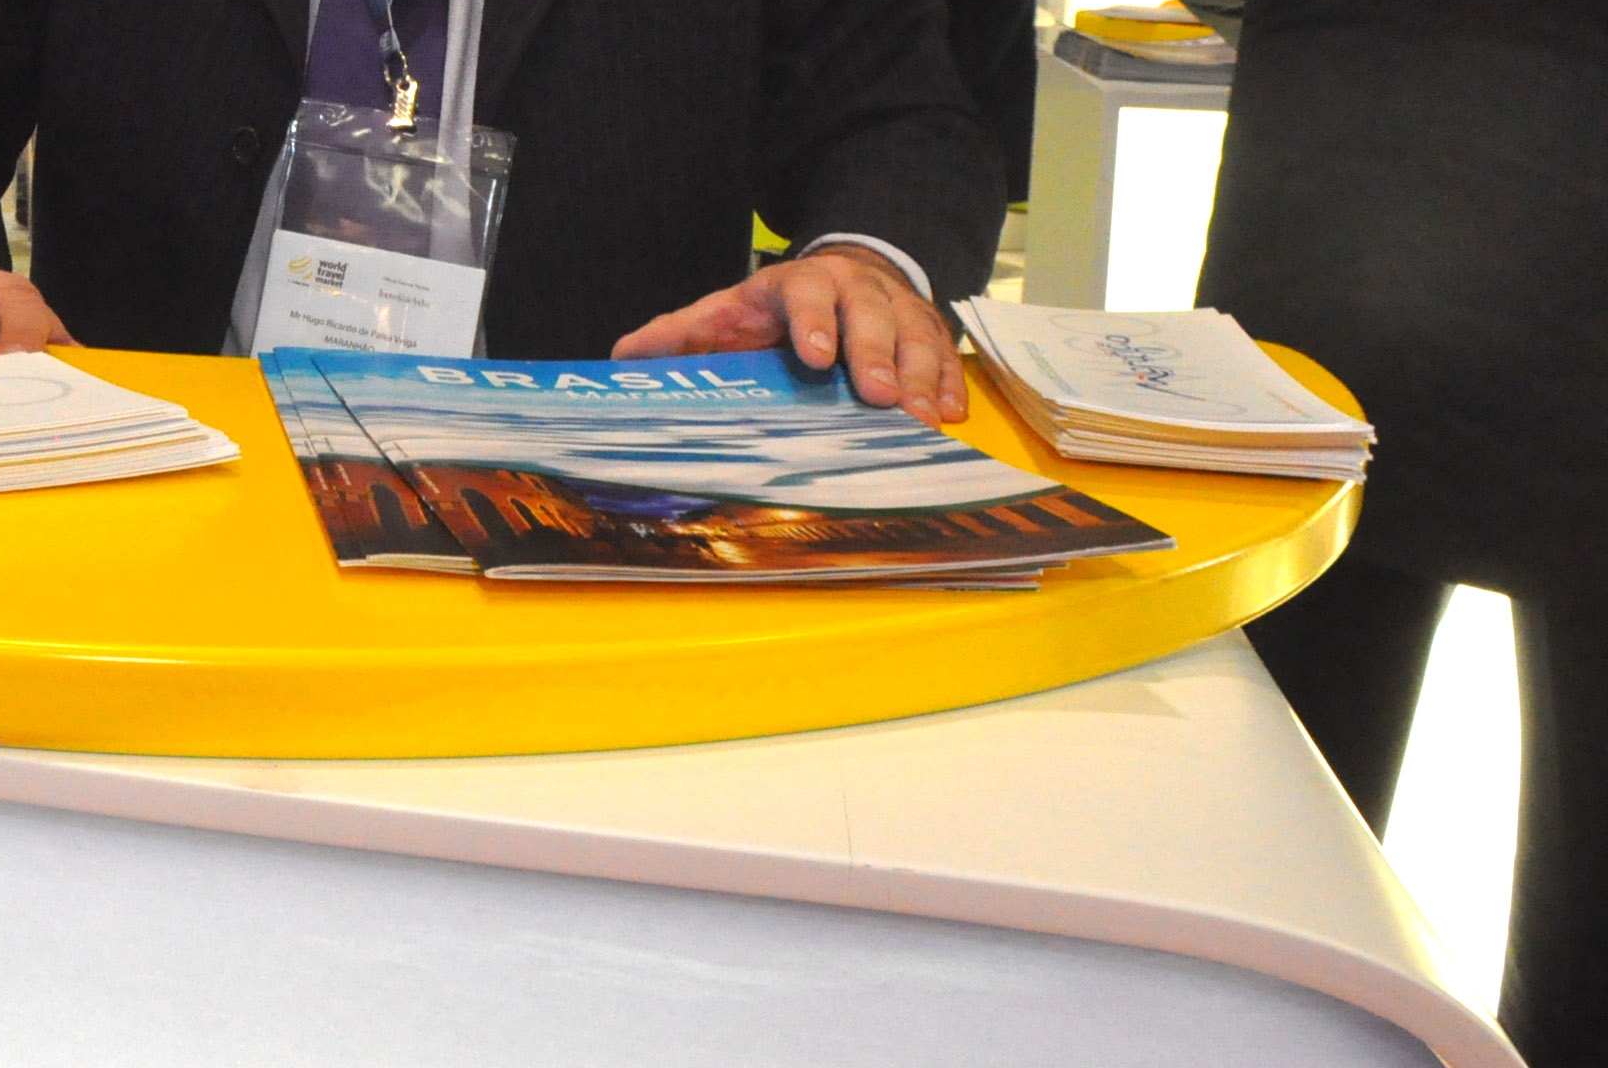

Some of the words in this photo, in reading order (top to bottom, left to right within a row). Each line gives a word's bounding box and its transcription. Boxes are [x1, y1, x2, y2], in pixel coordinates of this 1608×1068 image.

[318, 259, 348, 273] world
[317, 267, 346, 281] travel
[315, 276, 343, 289] market
[302, 313, 325, 327] Hugo
[326, 319, 358, 334] Ricardo
[358, 327, 370, 336] de
[416, 365, 758, 391] BRASIL
[565, 387, 771, 401] Maranhão
